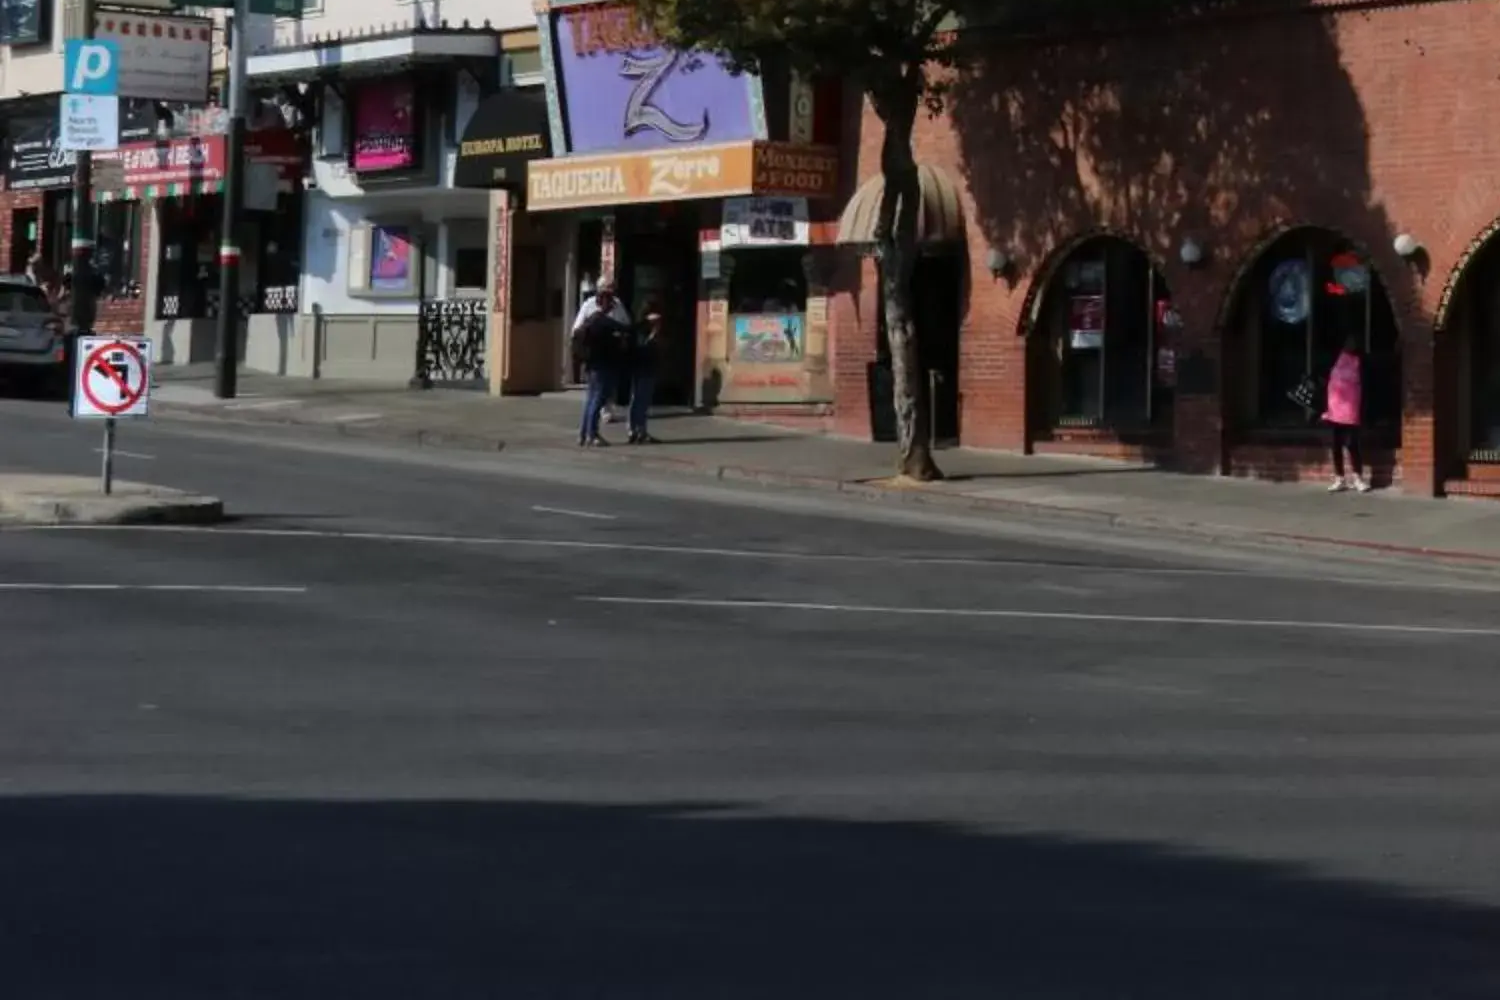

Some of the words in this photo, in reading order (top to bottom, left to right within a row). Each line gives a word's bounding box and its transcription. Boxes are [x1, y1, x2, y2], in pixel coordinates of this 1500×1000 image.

[461, 136, 505, 157] EUROPA
[505, 133, 543, 153] HOTEL
[530, 165, 627, 201] TAQUERIA
